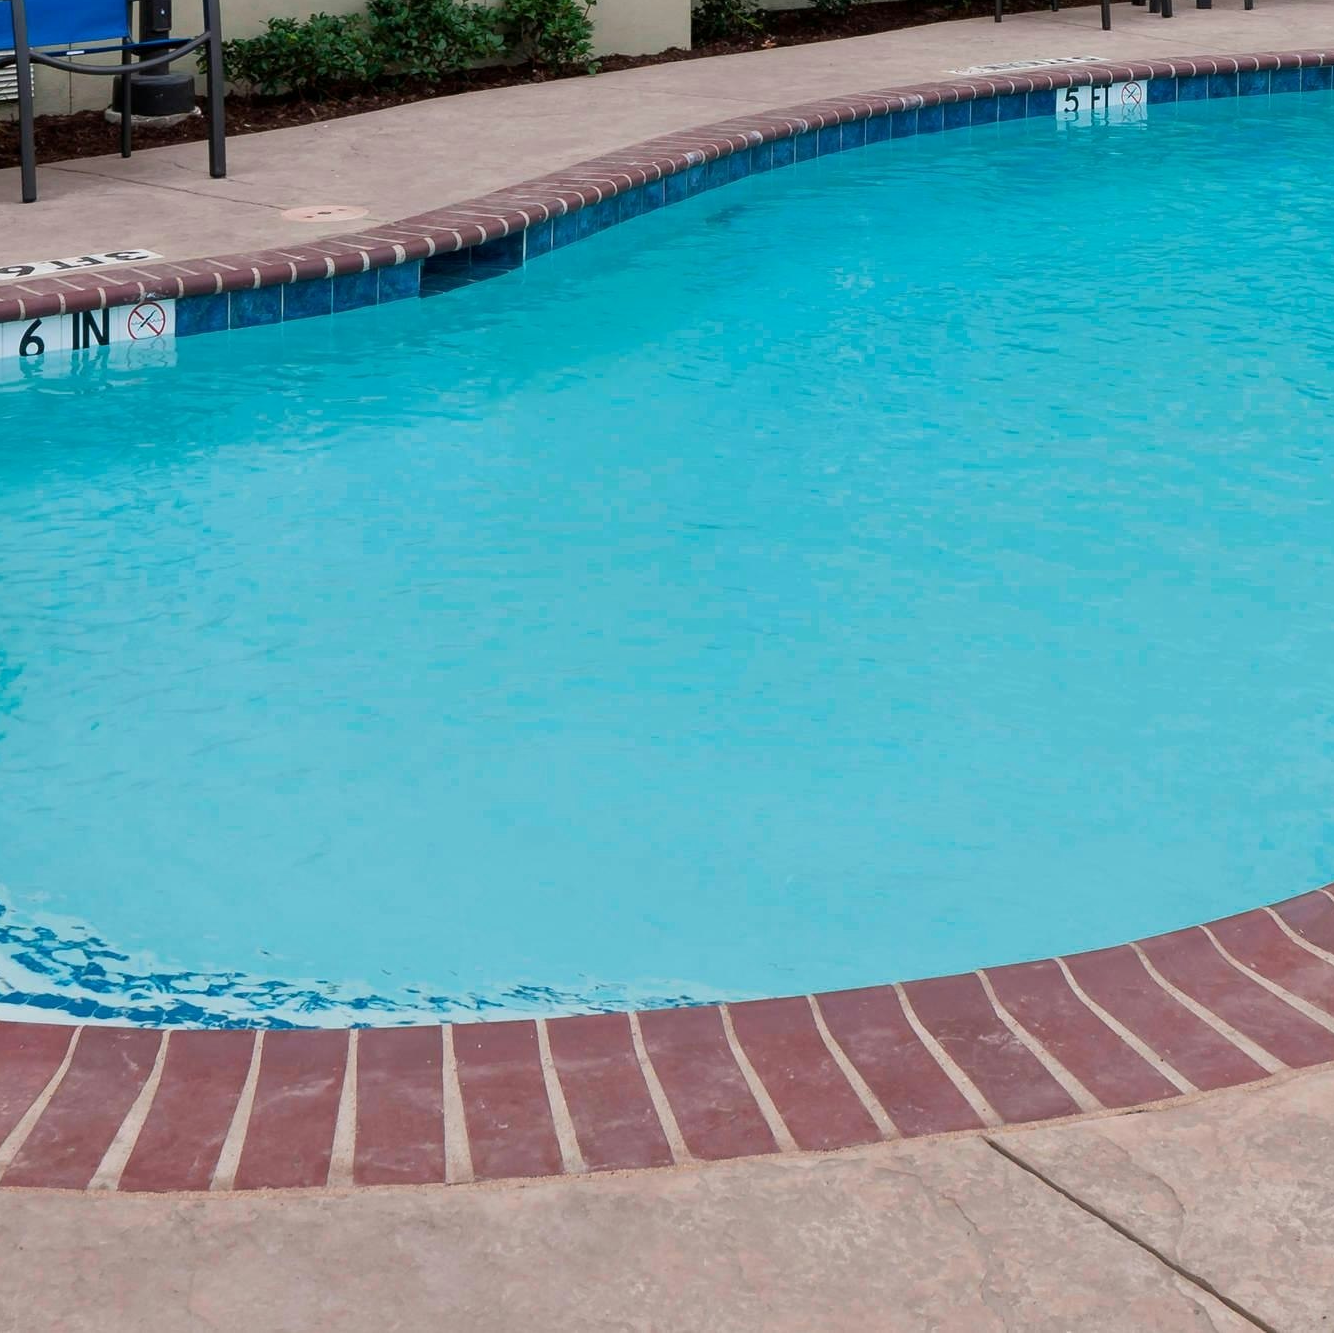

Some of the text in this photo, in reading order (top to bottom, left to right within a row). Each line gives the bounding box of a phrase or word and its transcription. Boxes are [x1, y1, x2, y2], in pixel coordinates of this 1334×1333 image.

[1064, 83, 1113, 112] 5 FT
[104, 250, 150, 261] 3
[19, 318, 45, 356] 6
[72, 307, 110, 351] IN
